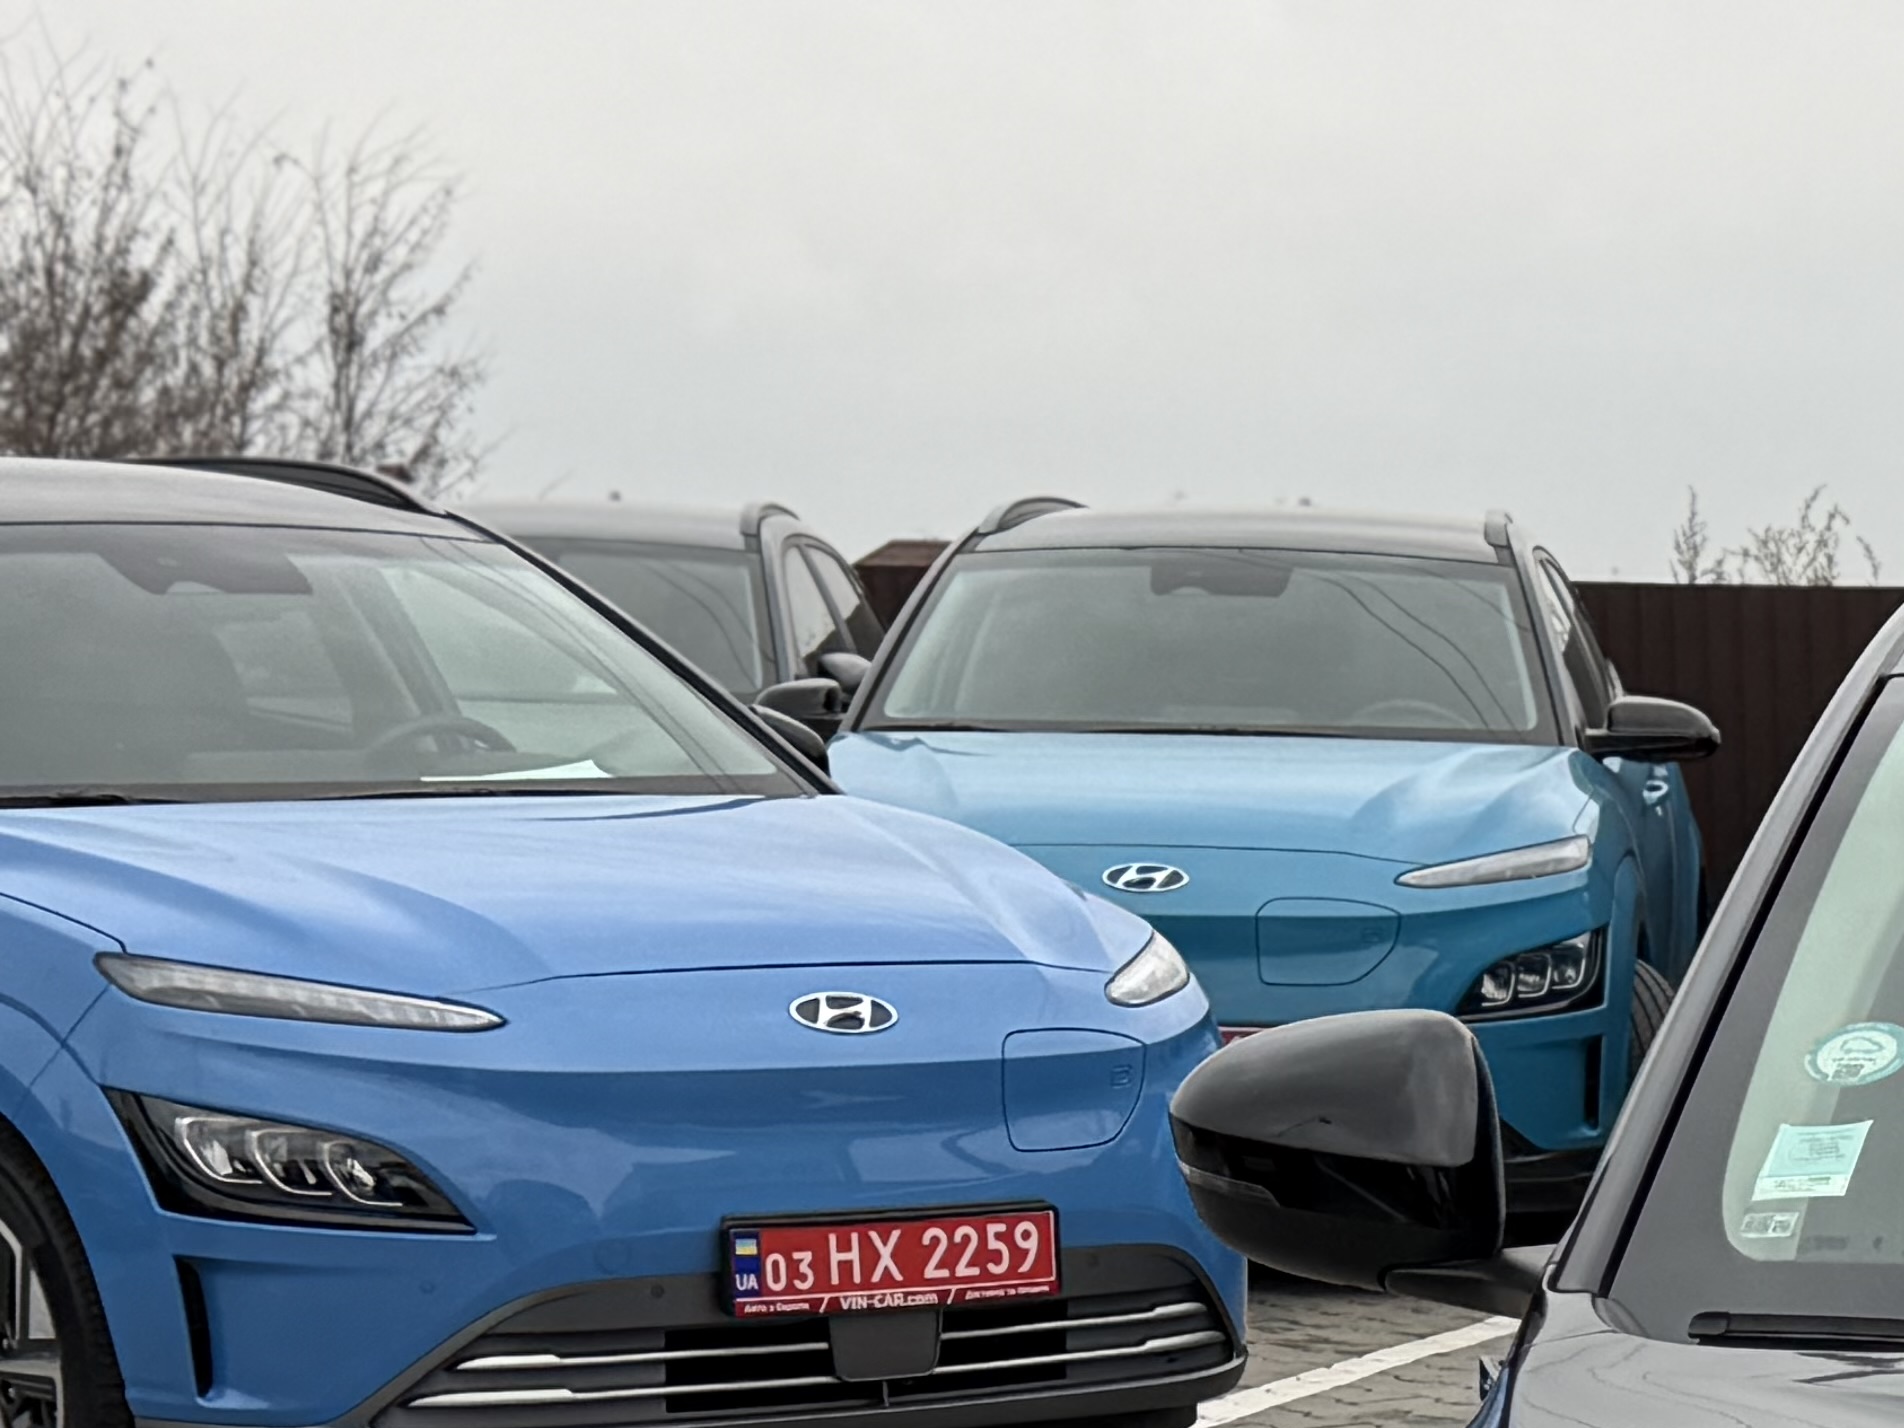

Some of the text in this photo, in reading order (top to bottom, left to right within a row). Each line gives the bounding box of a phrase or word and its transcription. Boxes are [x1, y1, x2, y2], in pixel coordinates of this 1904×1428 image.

[765, 1220, 1039, 1292] 03 HX 2259
[736, 1274, 758, 1291] UA
